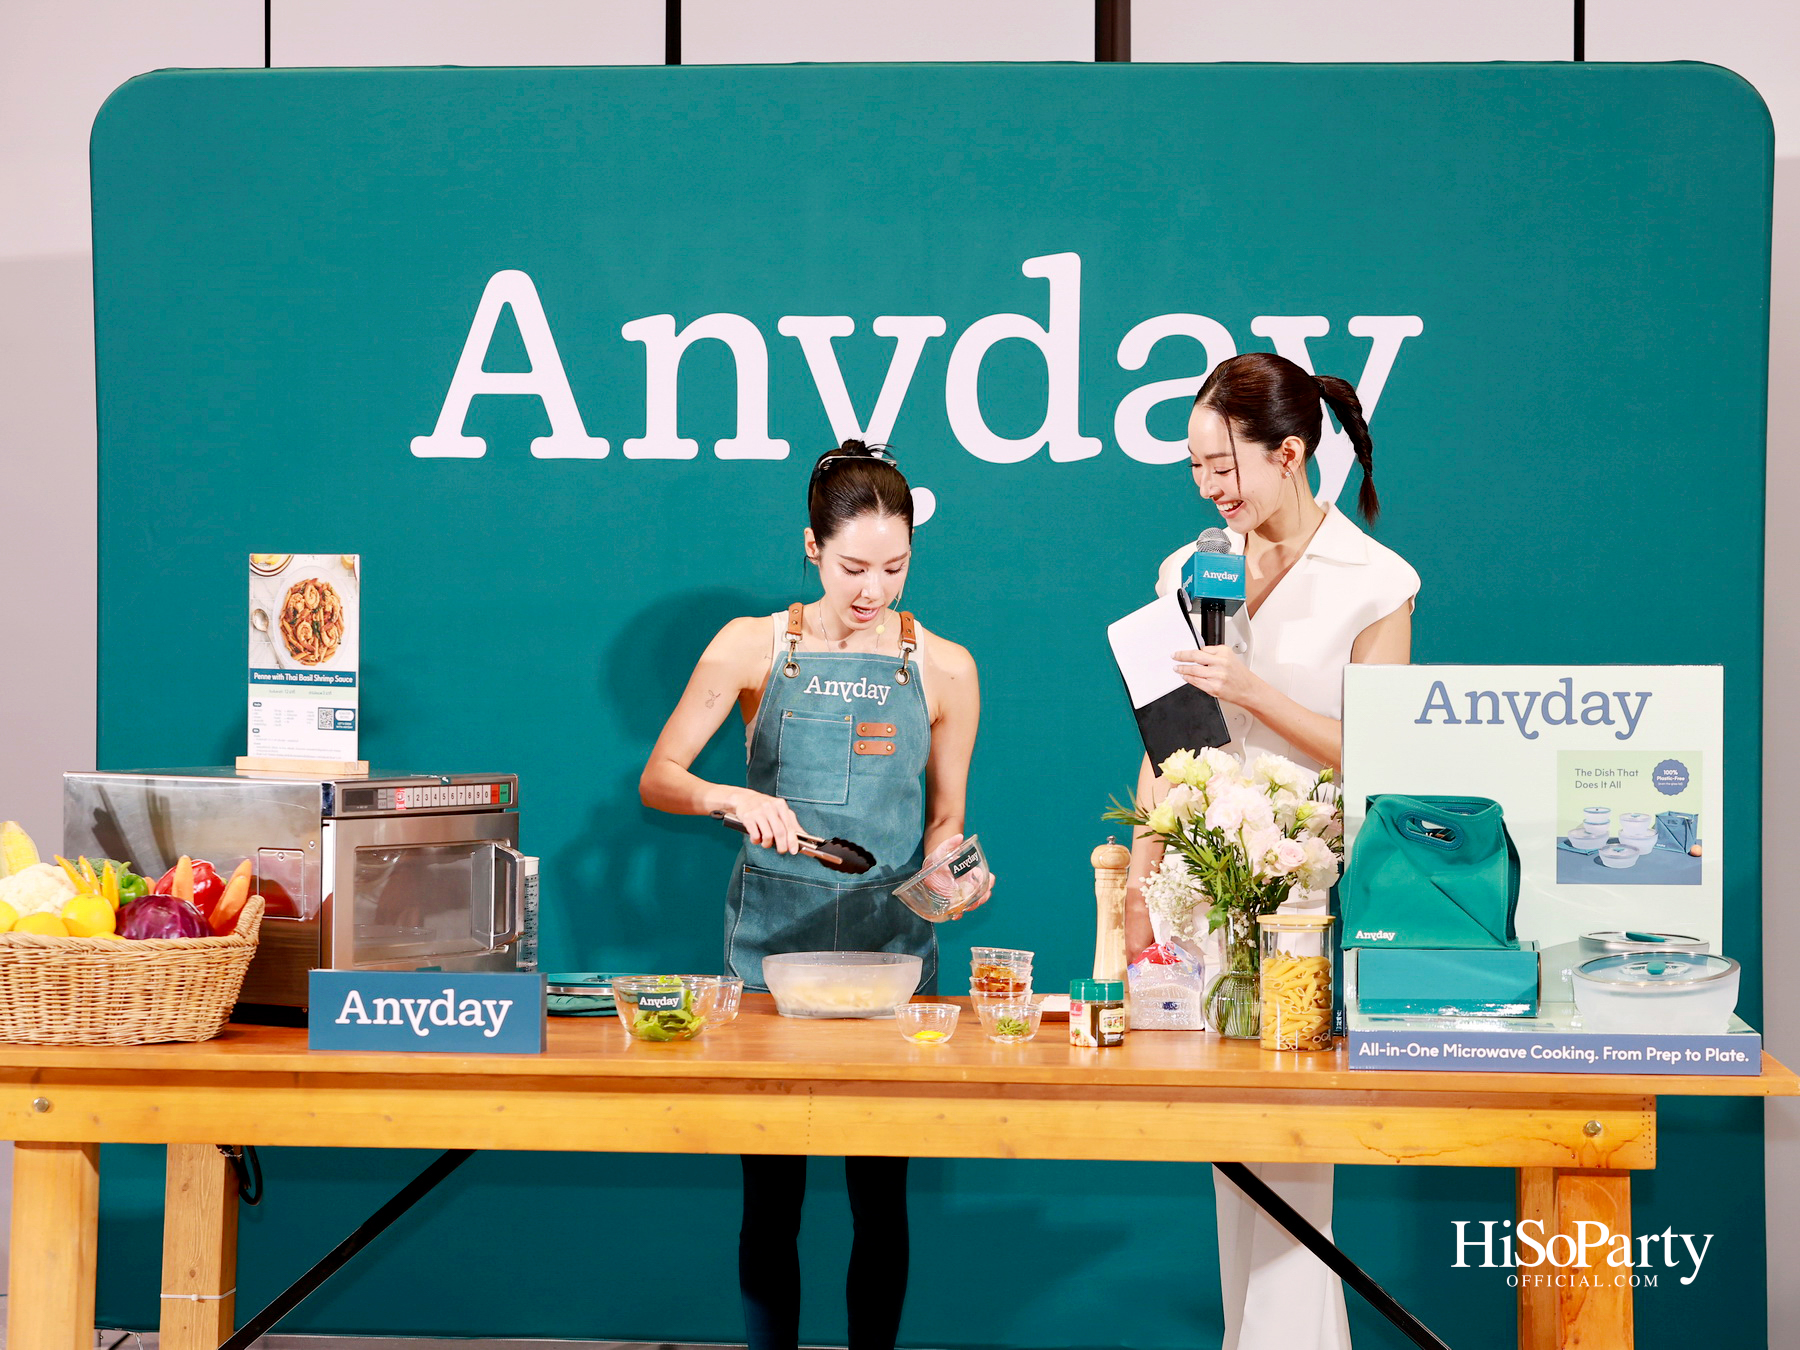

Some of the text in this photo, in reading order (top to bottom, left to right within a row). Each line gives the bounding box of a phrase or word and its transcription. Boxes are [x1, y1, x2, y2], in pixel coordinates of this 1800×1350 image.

[1202, 570, 1239, 583] Anyday
[253, 672, 353, 684] Penne with Thai Basil Shrimp Sauce
[803, 676, 891, 706] Anyday
[1414, 677, 1653, 741] Anyday
[1574, 768, 1639, 777] The Dish That
[1575, 780, 1622, 789] Does It All
[953, 851, 979, 875] Anyday
[1355, 930, 1396, 941] Anyday
[639, 996, 680, 1009] Anyday
[335, 988, 513, 1037] Anyday
[1358, 1042, 1750, 1065] All-in-One Microwave Cooking. From Prep to Plate.
